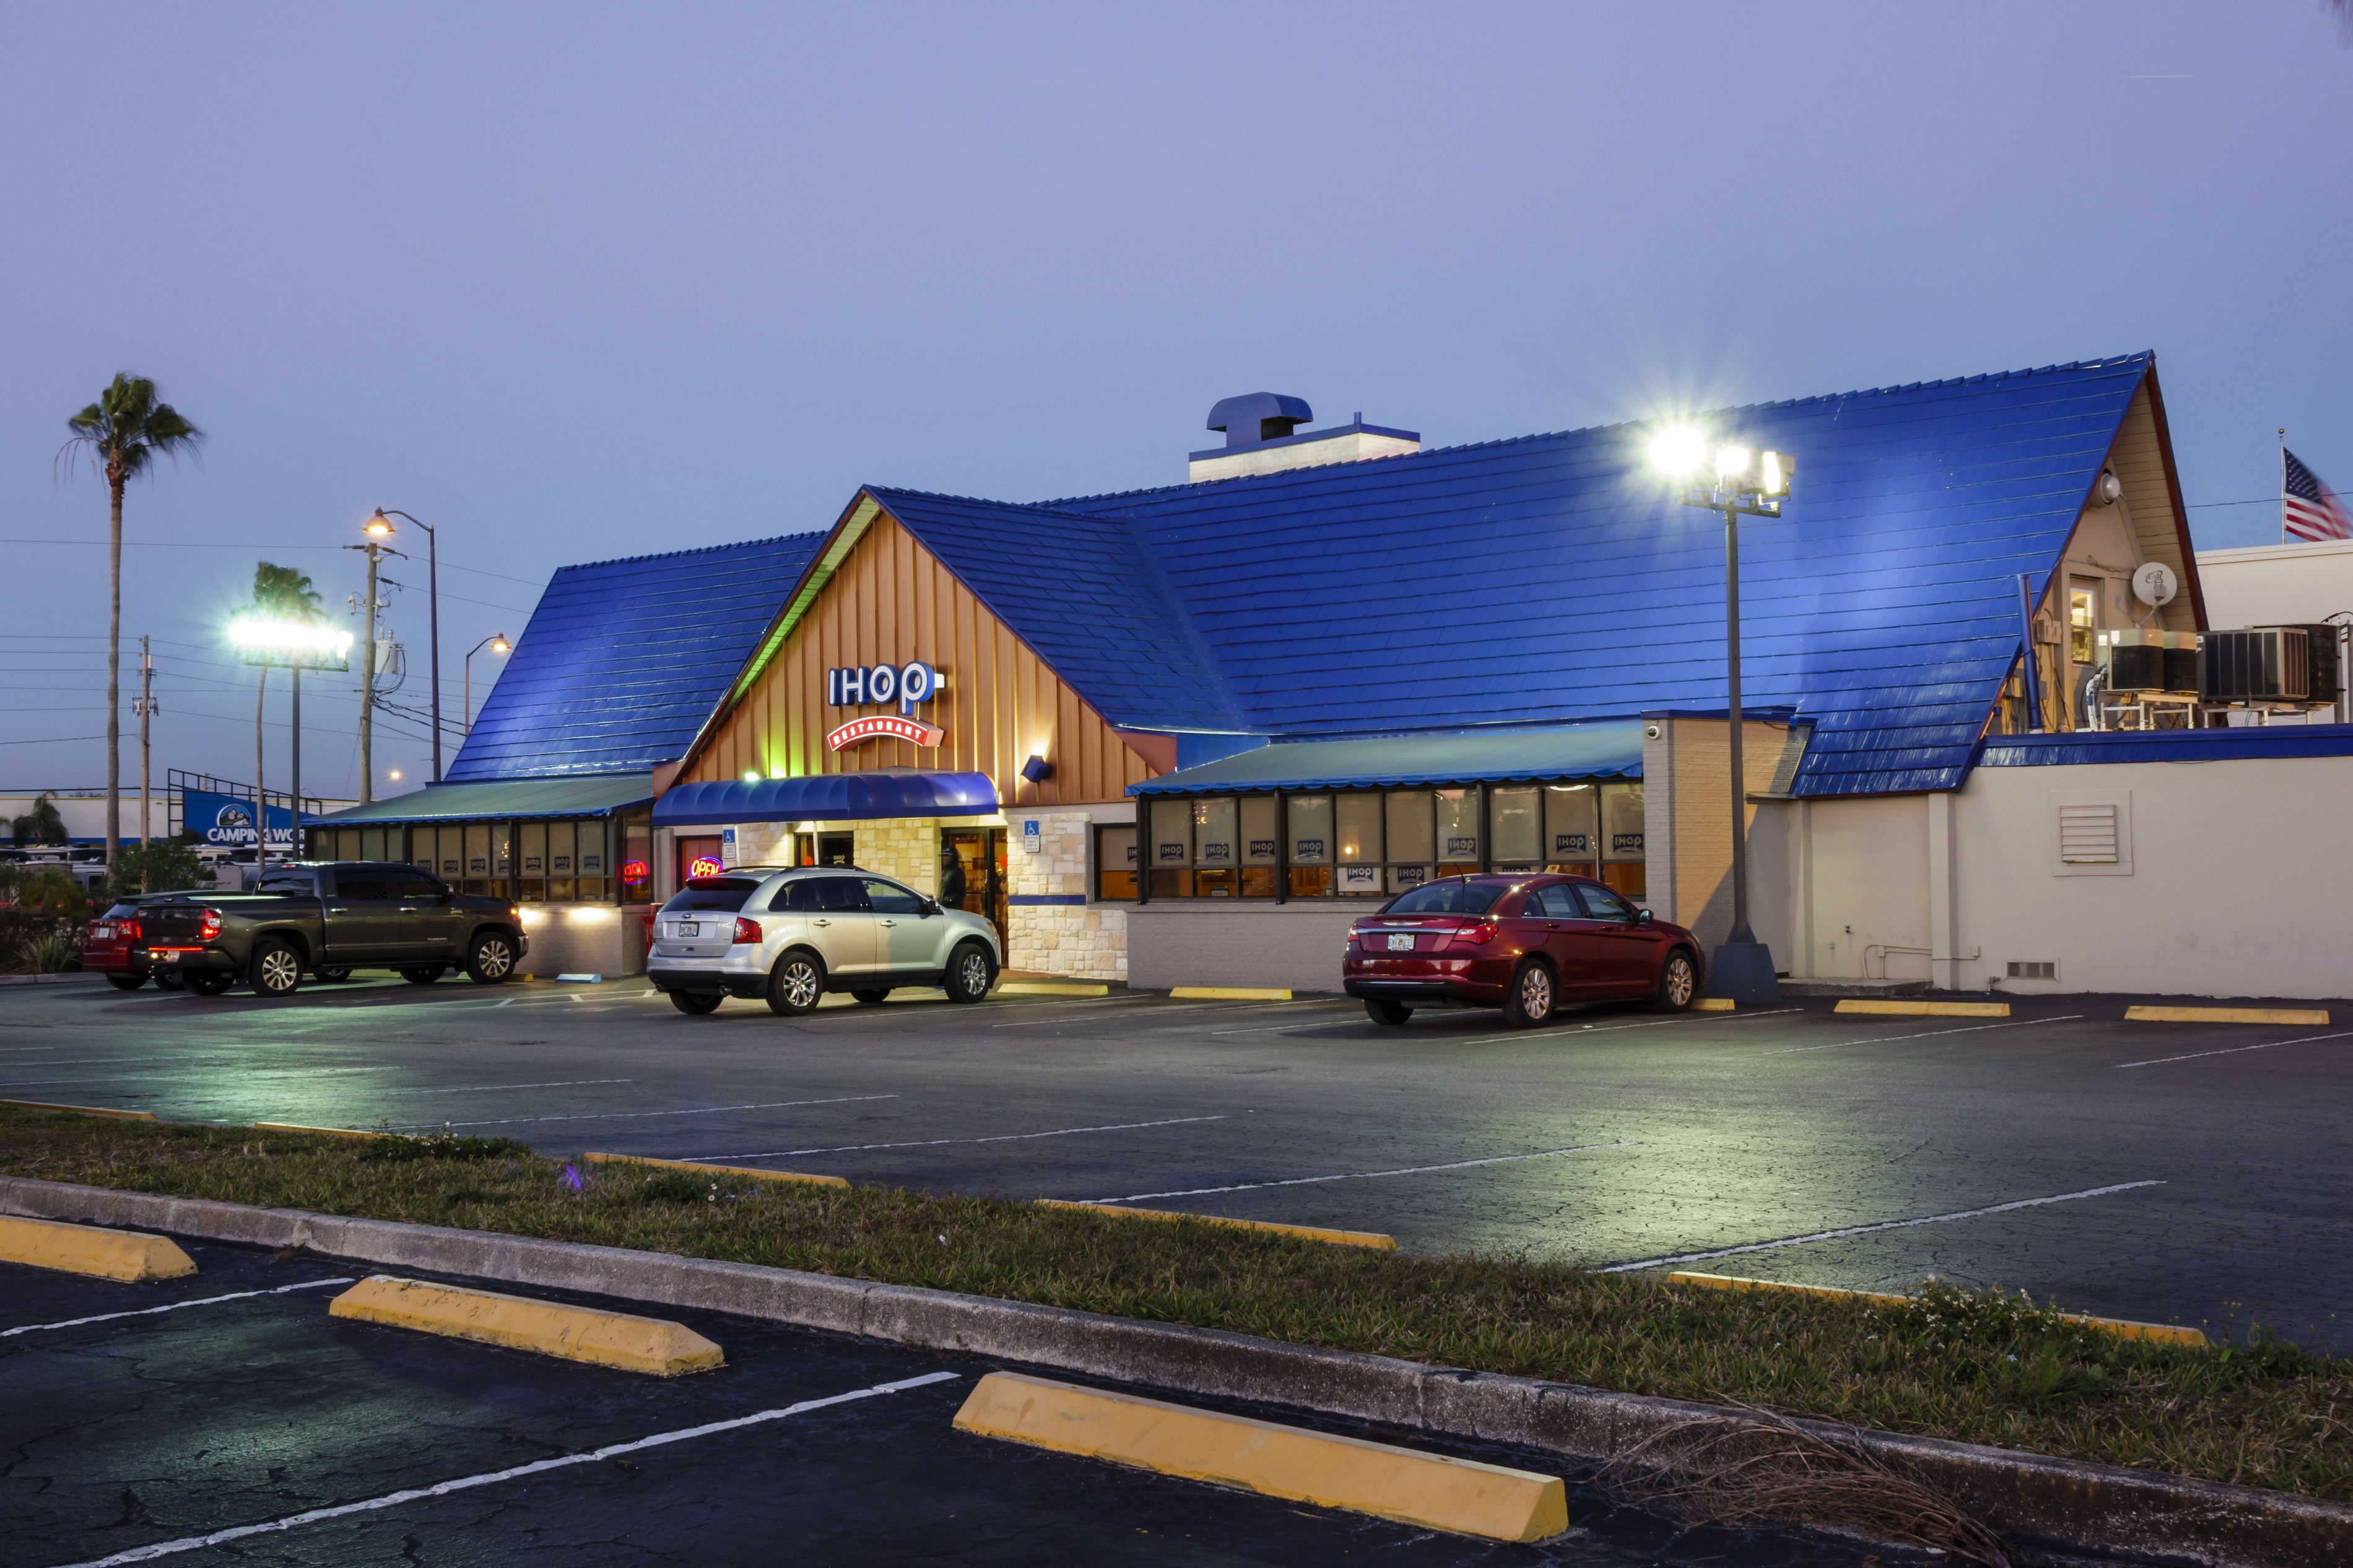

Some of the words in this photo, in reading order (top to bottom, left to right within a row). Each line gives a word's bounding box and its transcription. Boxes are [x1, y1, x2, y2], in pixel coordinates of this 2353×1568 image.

[829, 661, 934, 716] IHOP
[833, 721, 921, 745] RESTAURANT
[1450, 840, 1474, 851] IHOP
[1559, 837, 1585, 849] IHOP
[1615, 836, 1642, 847] IHOP
[1162, 846, 1182, 856] IHOP
[1207, 846, 1228, 856] IHOP
[1251, 842, 1273, 853] IHOP
[1299, 842, 1322, 853] IHOP
[471, 860, 484, 868] IHOP
[526, 858, 540, 867] IHOP
[555, 858, 569, 867] IHOP
[585, 858, 599, 867] IHOP
[691, 859, 719, 877] OPEN
[1349, 867, 1372, 878] IHOP
[1399, 868, 1423, 880] IHOP
